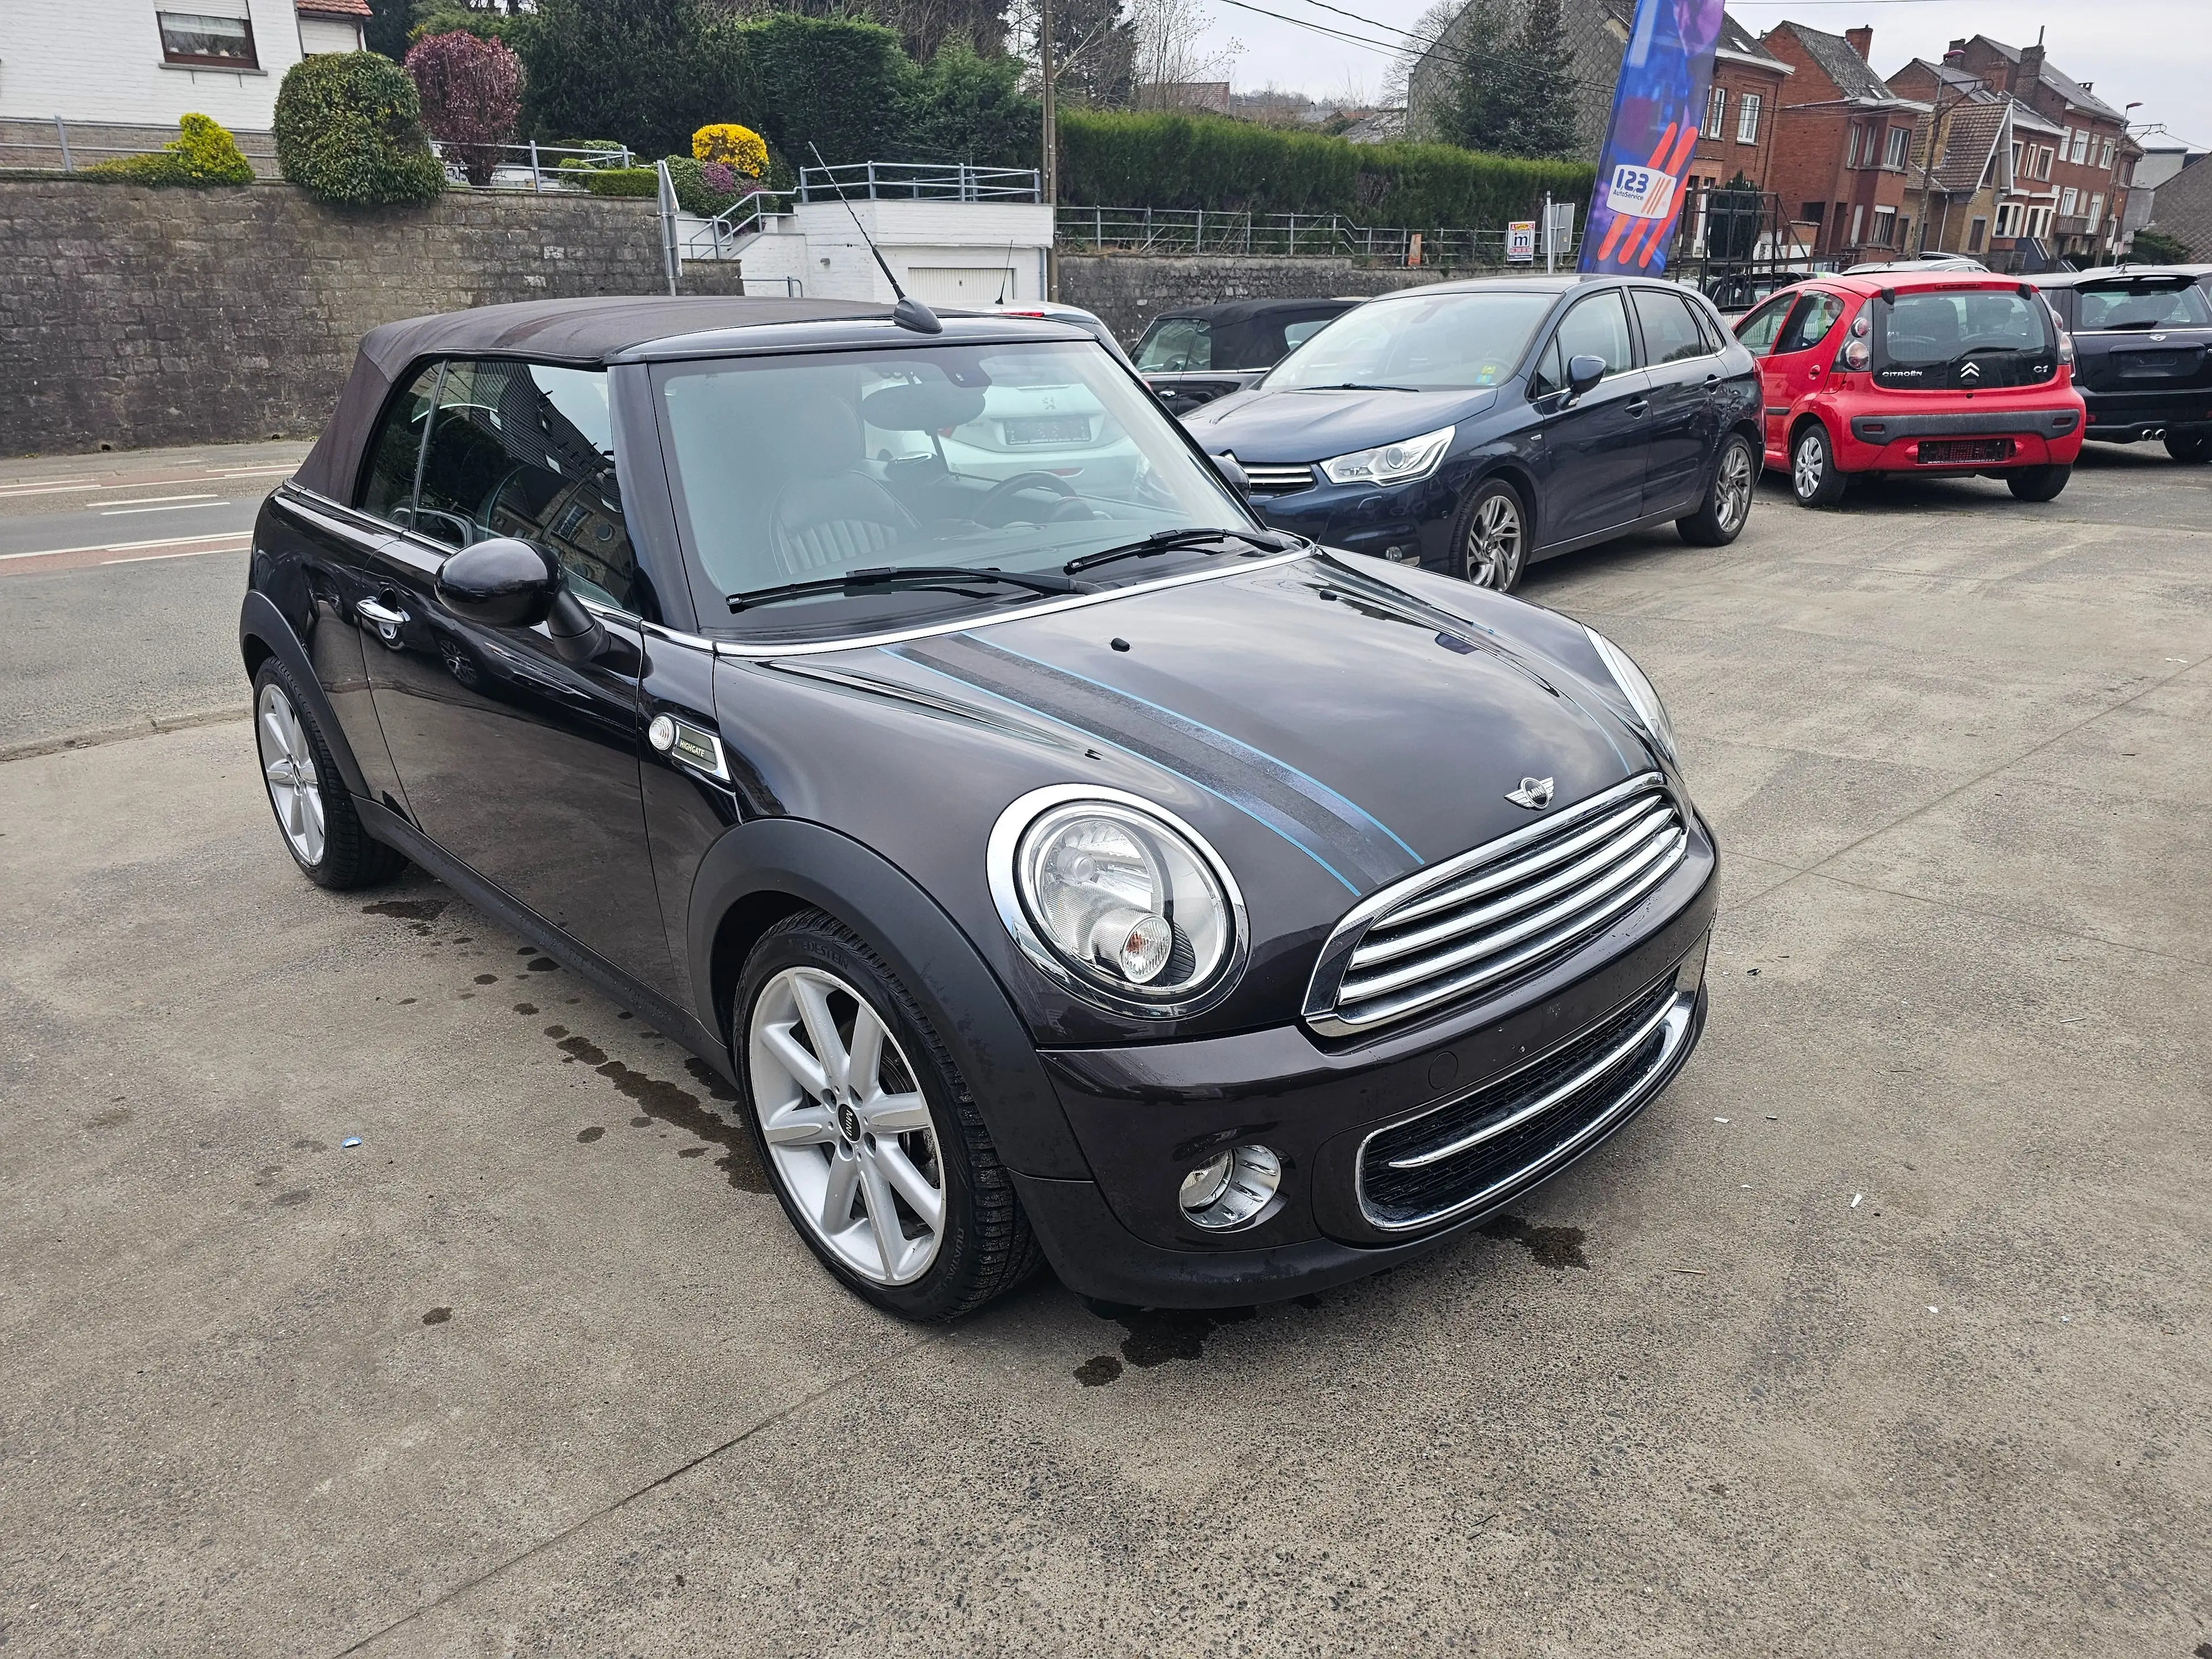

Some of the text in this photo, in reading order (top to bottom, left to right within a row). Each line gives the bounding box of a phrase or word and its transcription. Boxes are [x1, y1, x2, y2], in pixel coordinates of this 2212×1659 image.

[1616, 169, 1649, 194] 1,2,3
[1613, 190, 1643, 200] AutoService
[1514, 236, 1528, 246] m
[2033, 365, 2048, 373] C1
[680, 740, 705, 757] HIGHGATE
[1527, 786, 1546, 799] MINI
